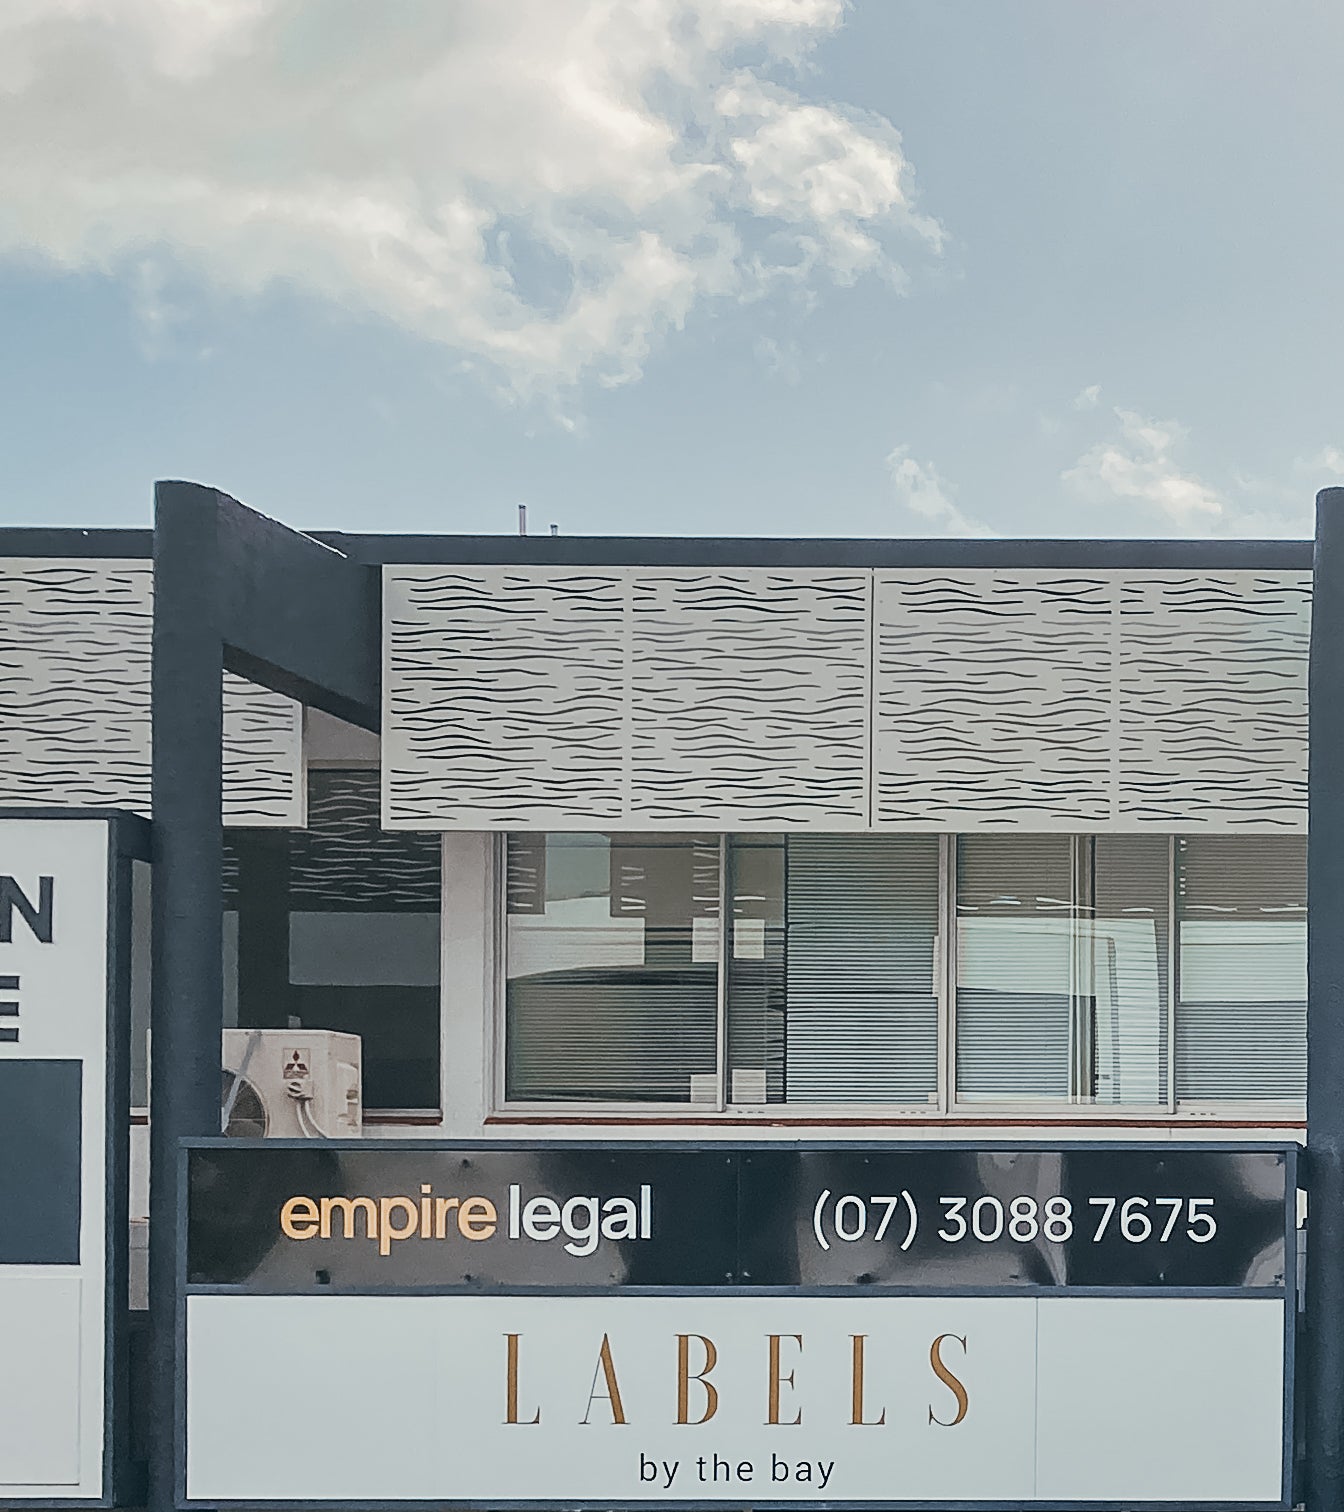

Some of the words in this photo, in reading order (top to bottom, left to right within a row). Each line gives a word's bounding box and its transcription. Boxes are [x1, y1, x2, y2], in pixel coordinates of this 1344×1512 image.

[279, 1184, 498, 1256] empire
[508, 1184, 652, 1257] legal
[812, 1189, 918, 1251] (07)
[937, 1195, 1074, 1244] 3088
[1088, 1196, 1217, 1244] 7675
[501, 1332, 969, 1427] LABELS
[639, 1453, 680, 1489] by
[696, 1453, 755, 1482] the
[771, 1453, 835, 1489] bay
